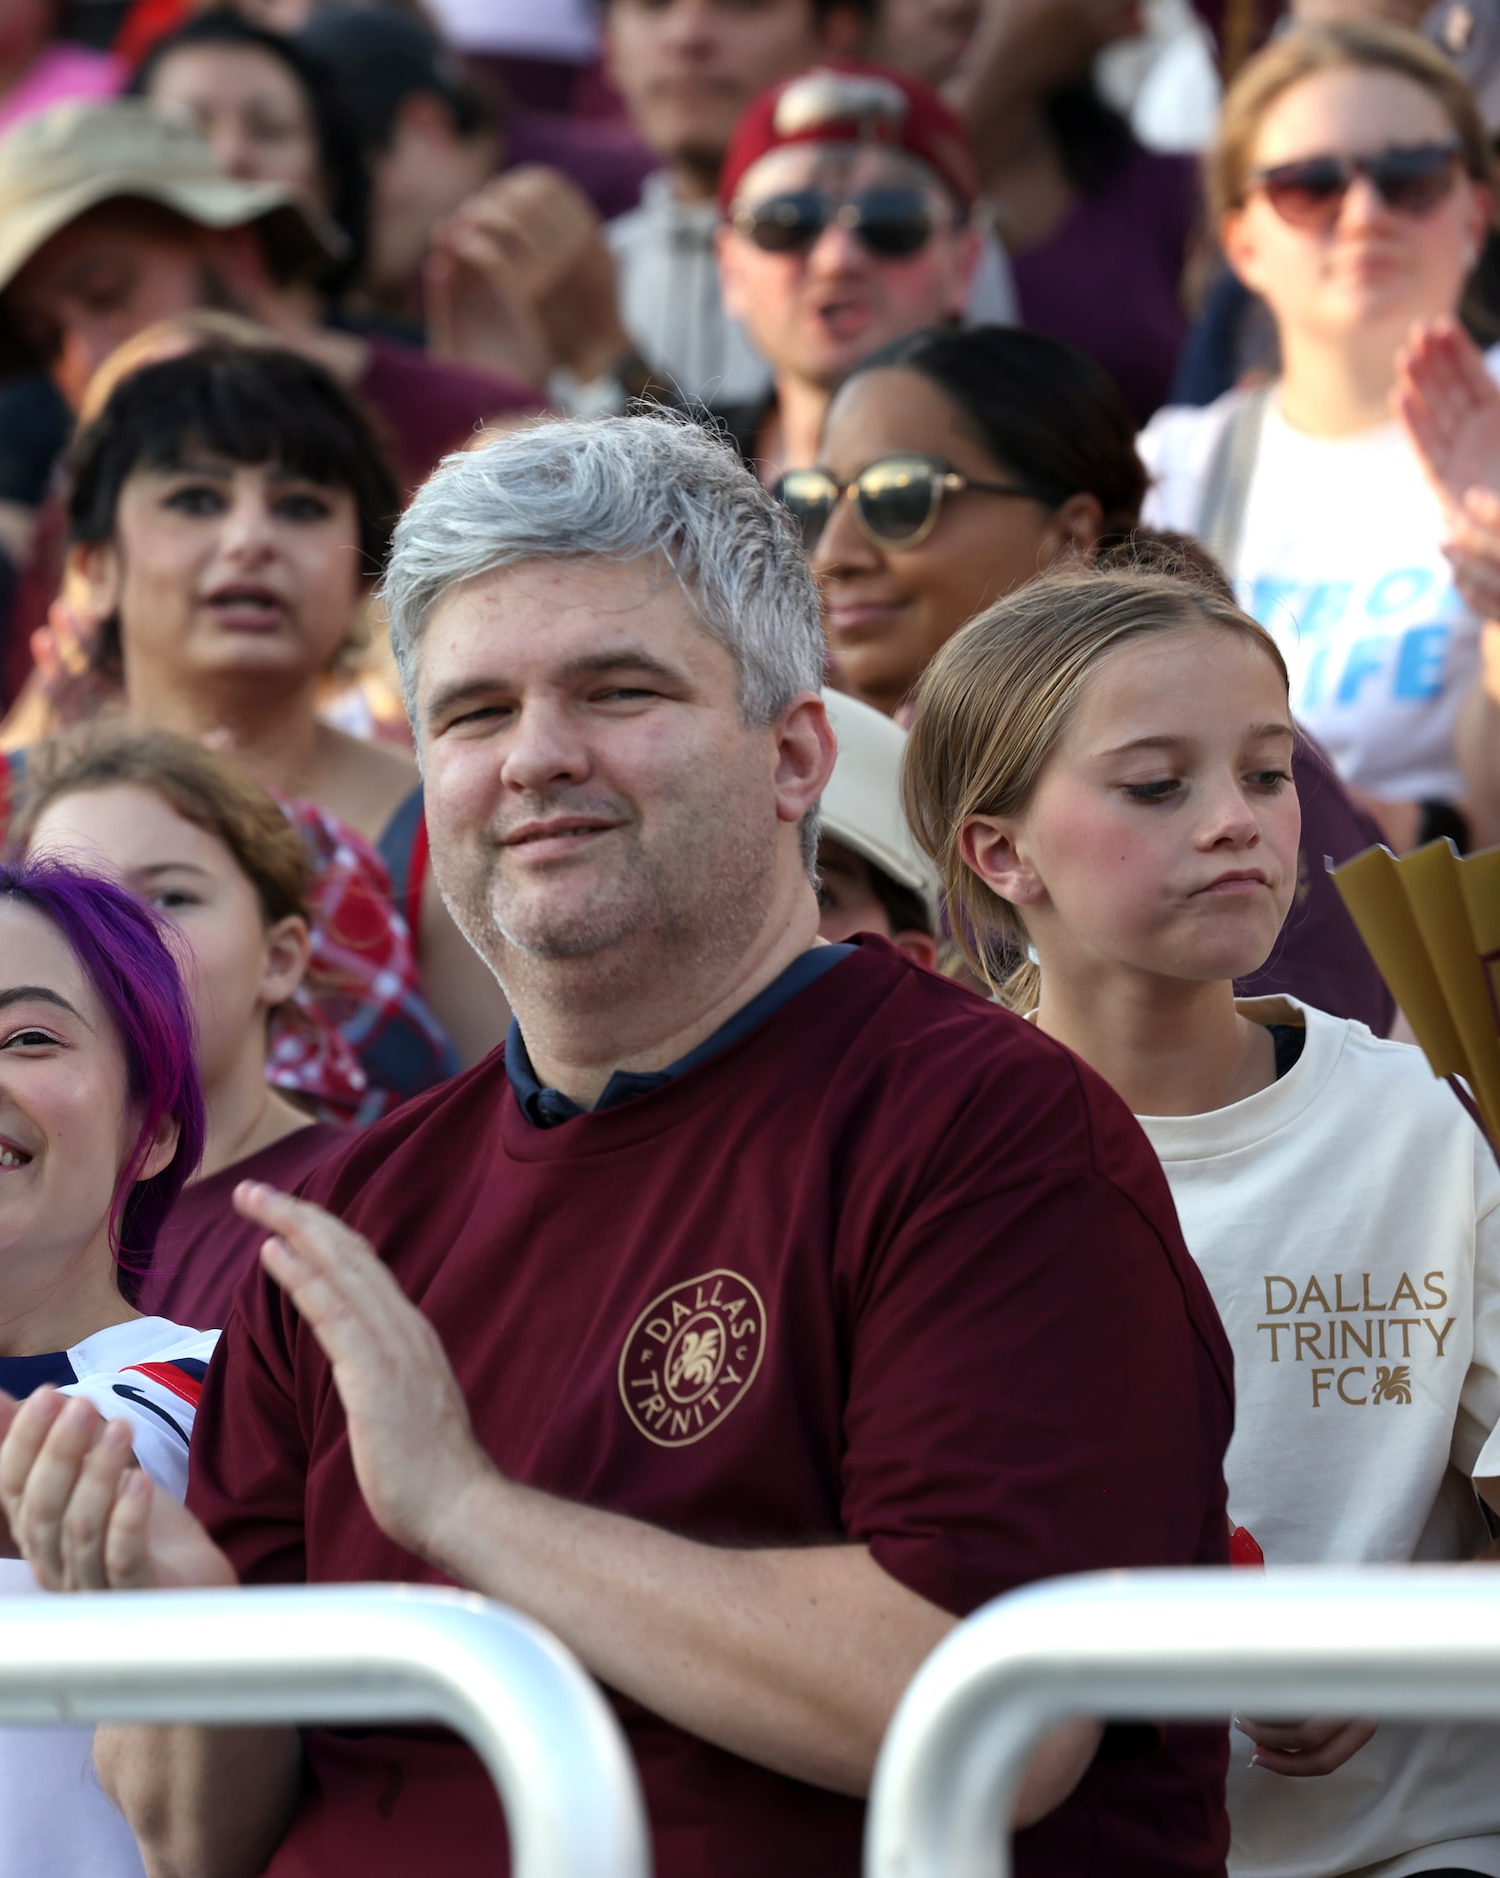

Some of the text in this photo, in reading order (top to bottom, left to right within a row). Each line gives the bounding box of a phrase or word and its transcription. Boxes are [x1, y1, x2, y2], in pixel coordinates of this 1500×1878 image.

[644, 1280, 756, 1345] DALLAS
[1263, 1271, 1448, 1315] DALLAS
[1257, 1317, 1457, 1362] TRINITY
[631, 1364, 743, 1436] TRINITY
[1311, 1366, 1368, 1408] FC
